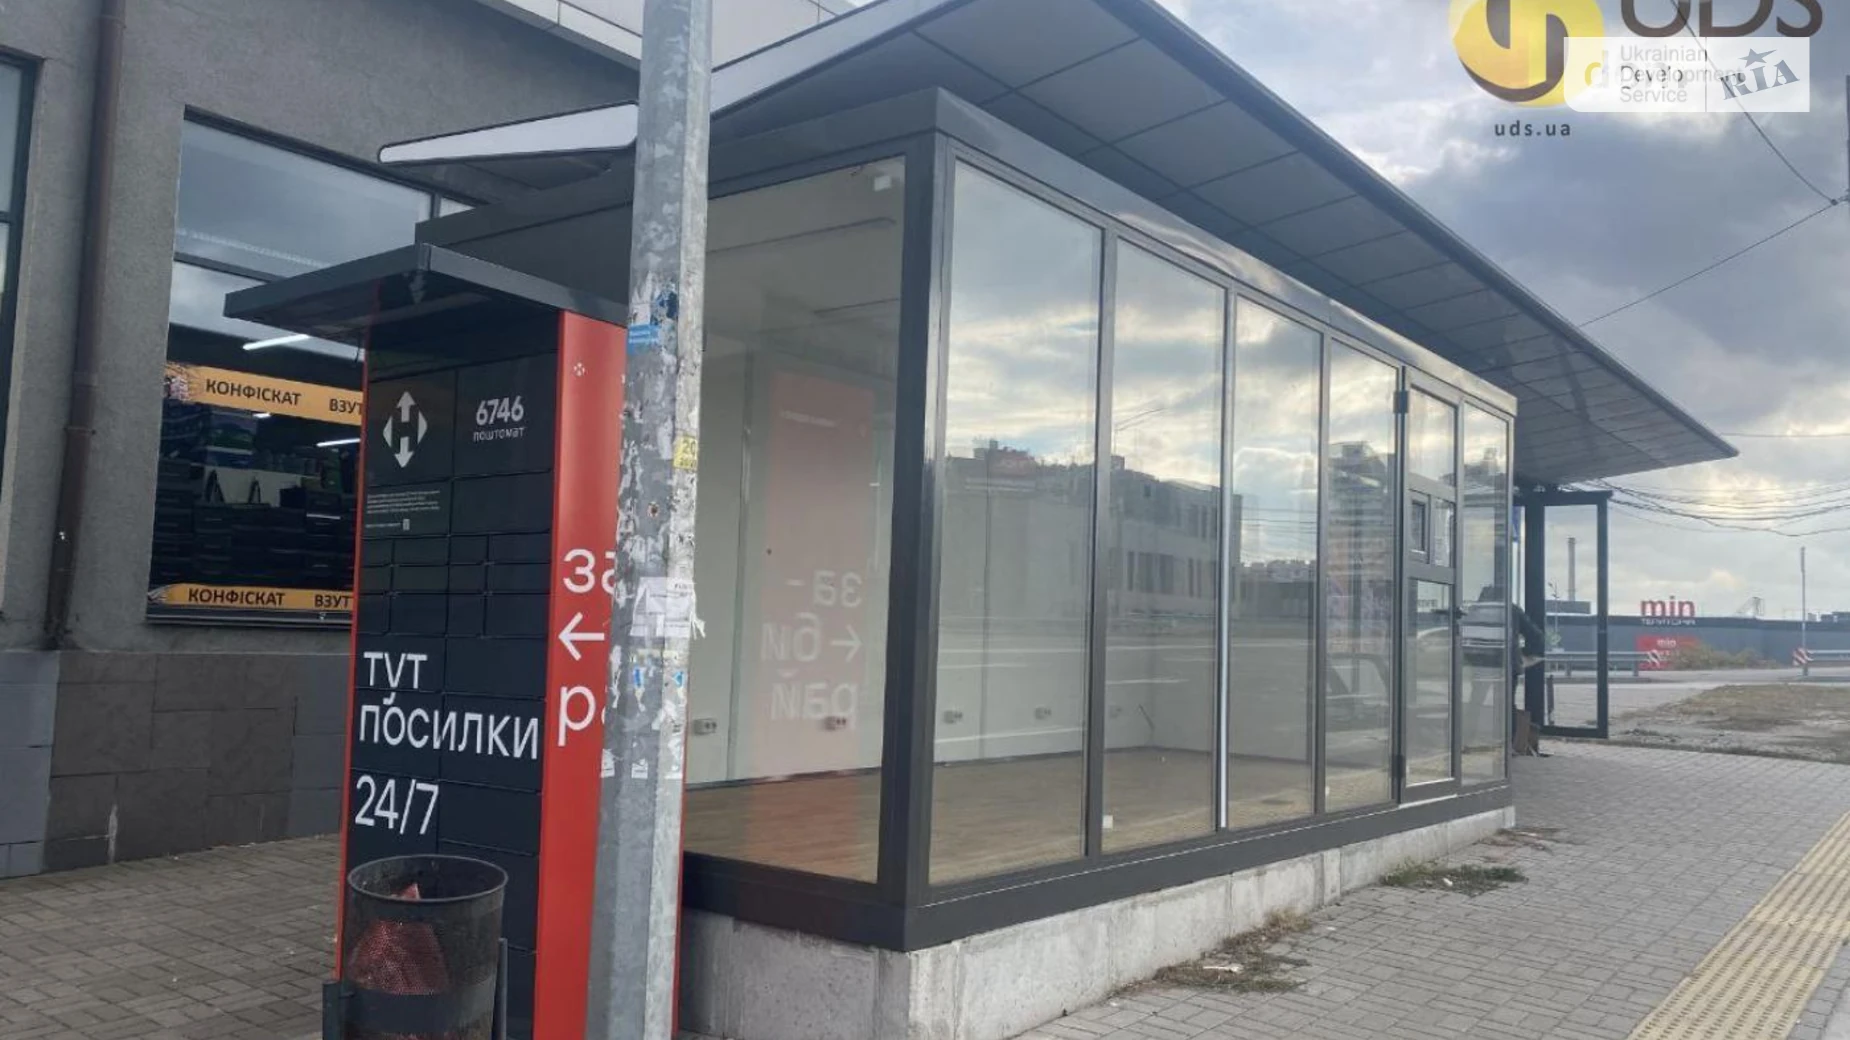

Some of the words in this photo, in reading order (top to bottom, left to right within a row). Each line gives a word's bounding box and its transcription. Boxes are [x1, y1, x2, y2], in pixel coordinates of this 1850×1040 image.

[206, 378, 301, 406] КОНФІСКАТ
[476, 395, 524, 426] 6746
[474, 426, 526, 442] поштомат
[188, 588, 286, 606] КОНФІСКАТ
[1640, 595, 1695, 618] min
[363, 651, 428, 705] тут
[557, 685, 606, 747] р
[359, 704, 539, 760] посилки
[354, 774, 439, 835] 24/7
